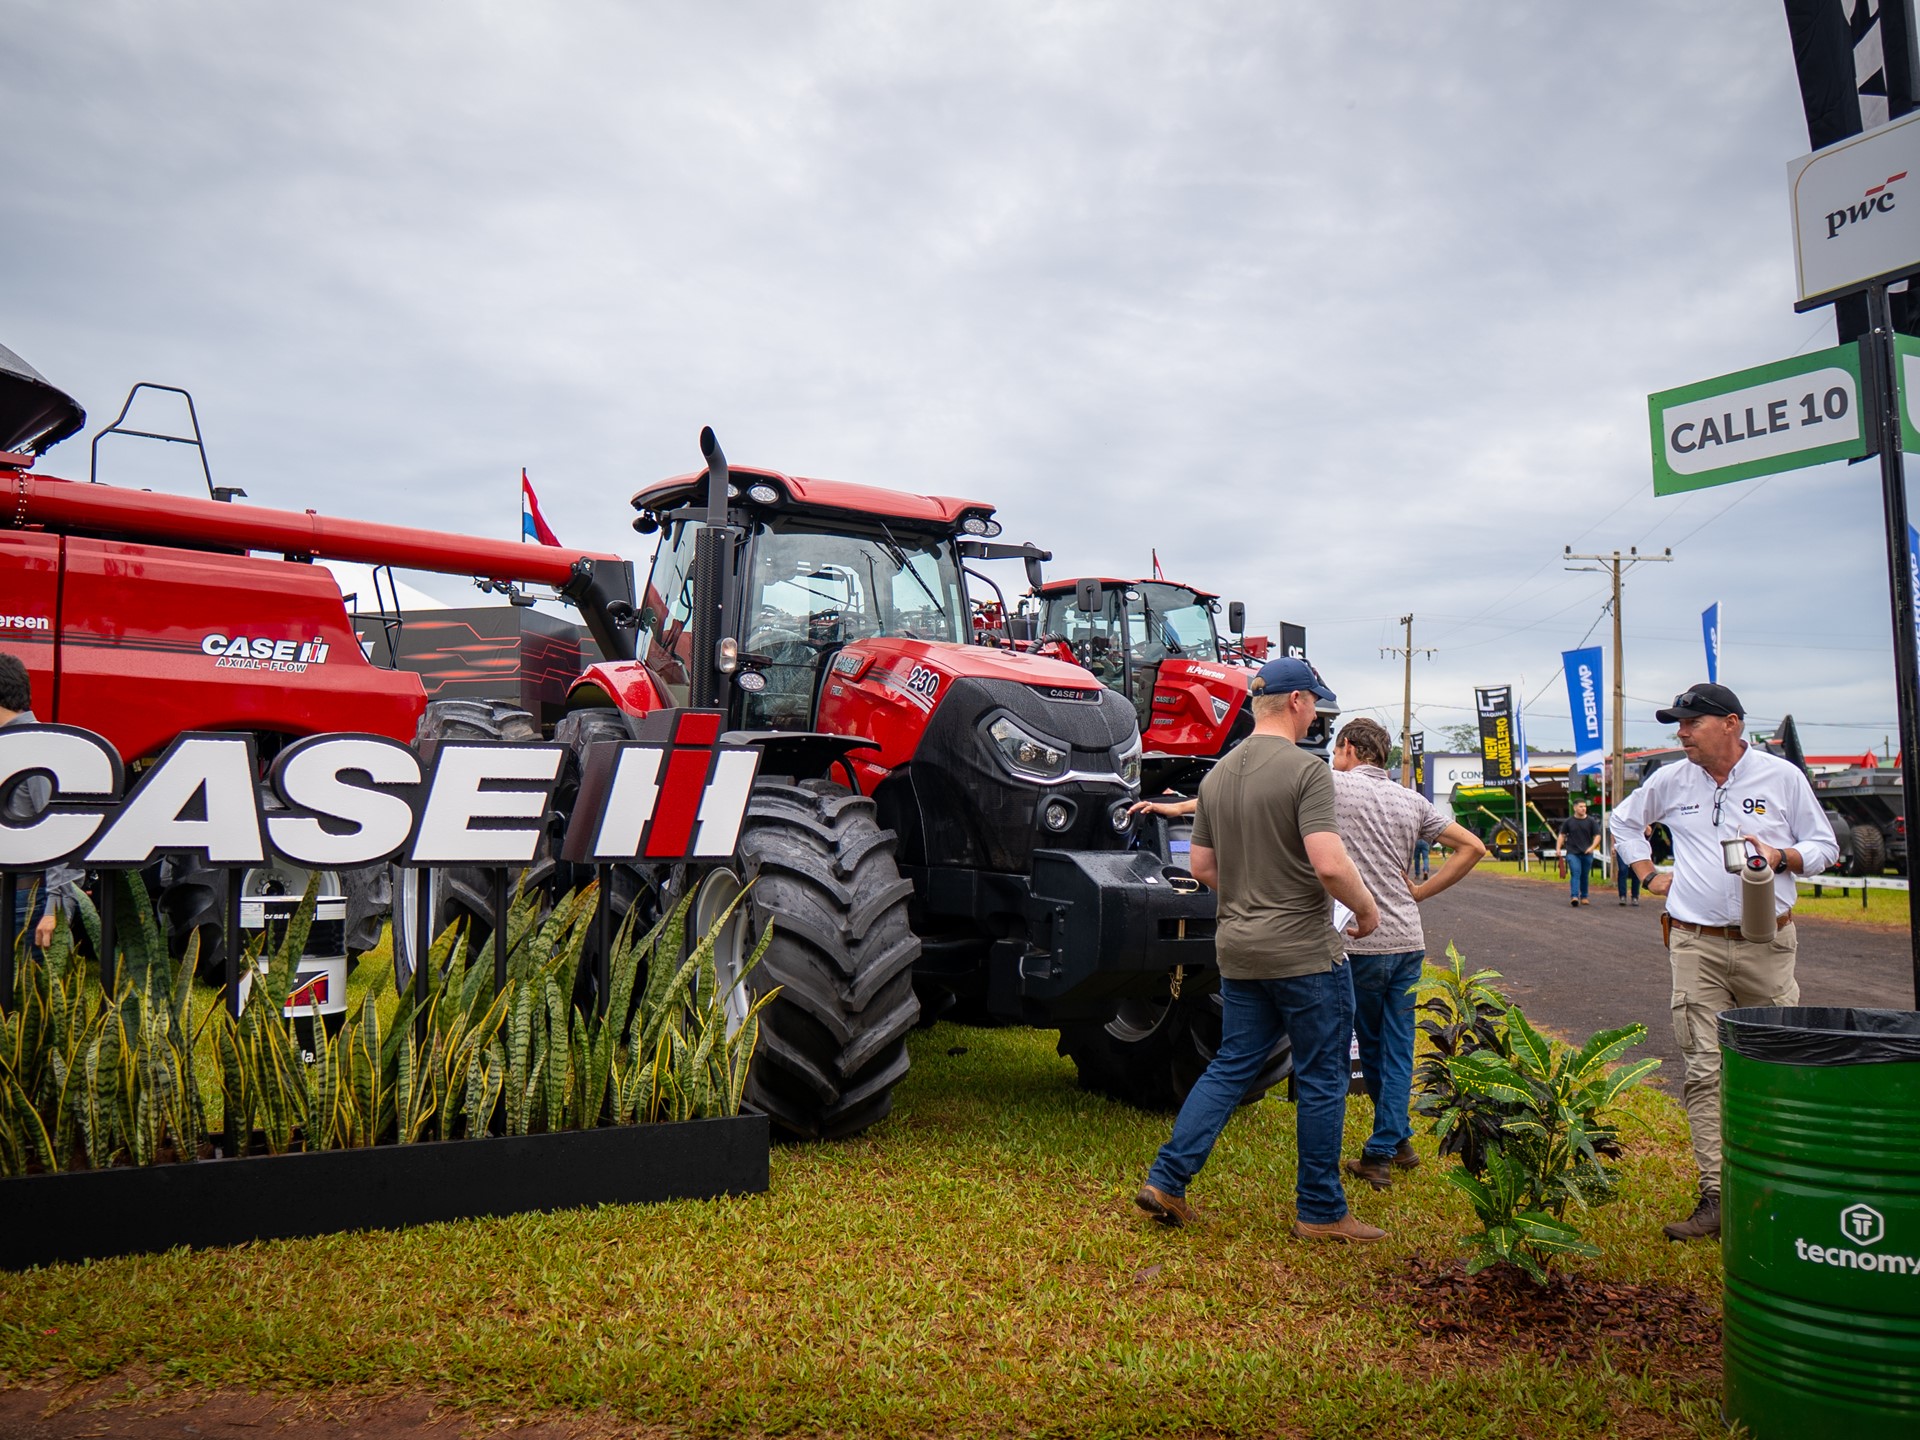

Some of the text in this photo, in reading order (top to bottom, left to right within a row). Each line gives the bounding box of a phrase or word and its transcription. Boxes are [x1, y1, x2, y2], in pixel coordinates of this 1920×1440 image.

[1825, 192, 1895, 239] pwc
[1671, 387, 1848, 453] CALLE 10
[201, 634, 298, 661] CASE
[215, 656, 308, 673] AXIAL-FLOW
[907, 666, 940, 699] 230
[1050, 689, 1075, 698] CASE
[1578, 664, 1599, 739] LIDERMAP
[1484, 736, 1498, 759] NEW
[1496, 717, 1512, 777] GRANELERO
[0, 728, 563, 864] CASE
[1743, 798, 1766, 815] 95
